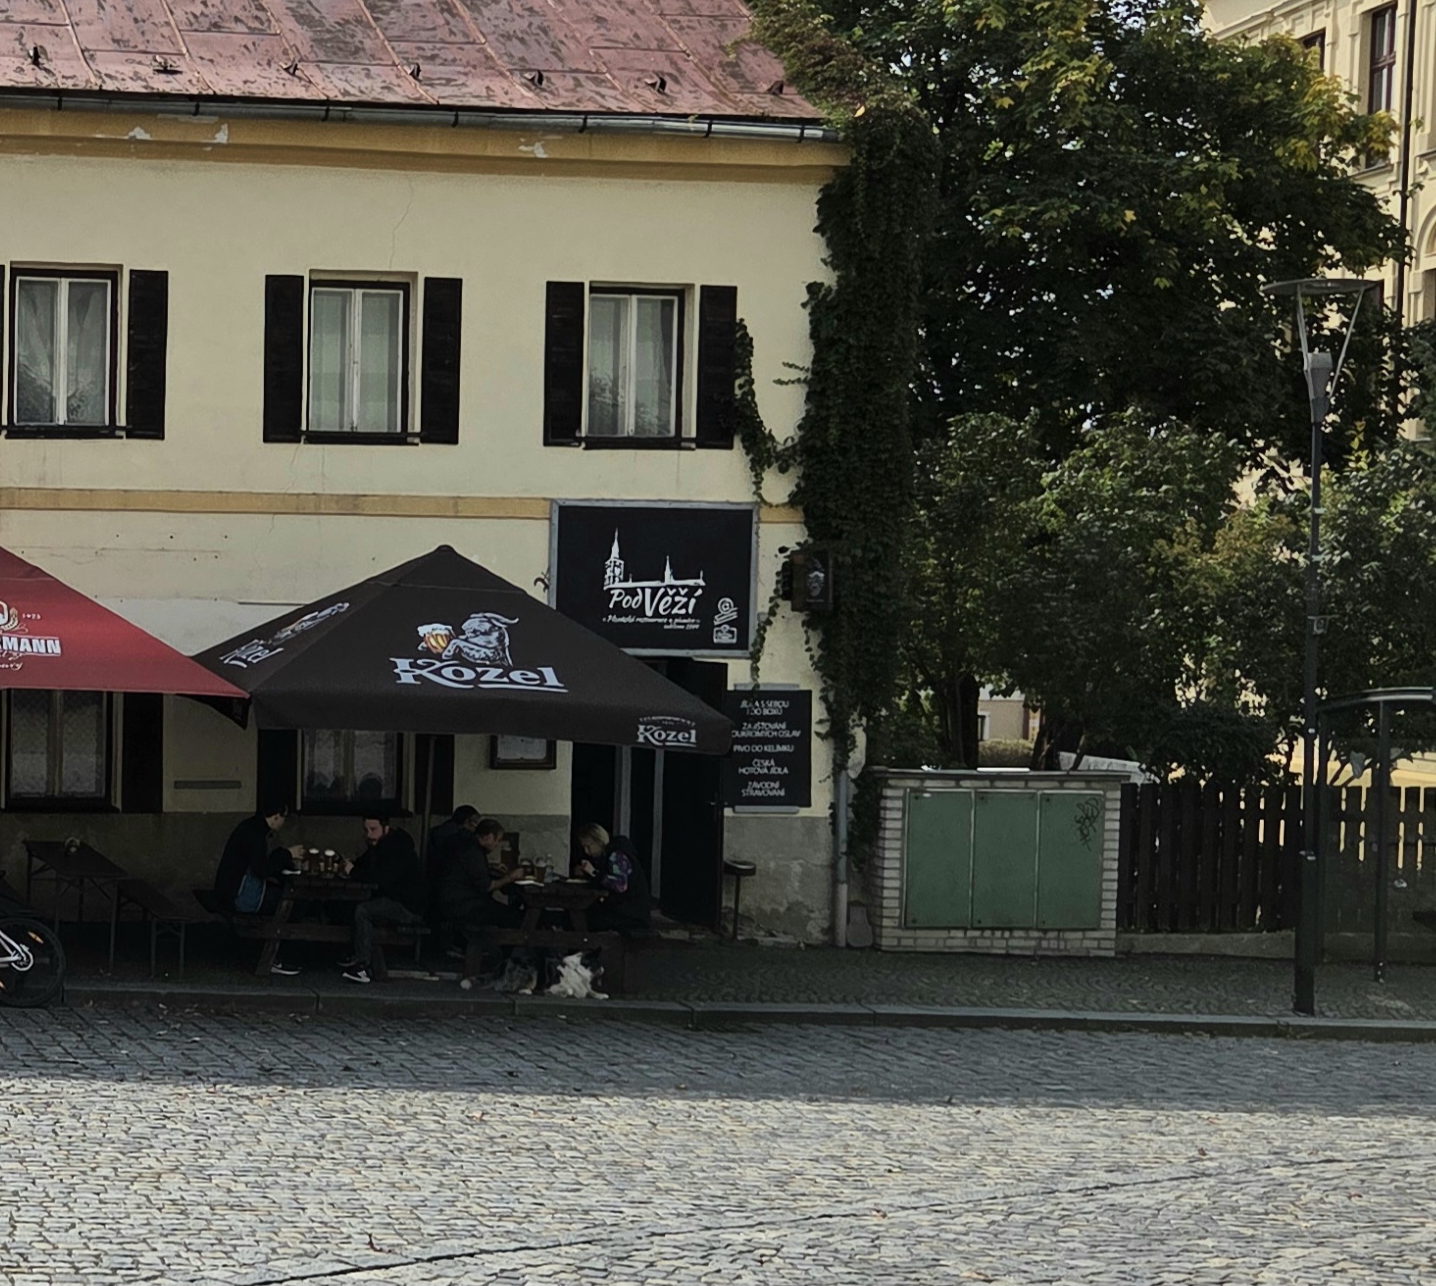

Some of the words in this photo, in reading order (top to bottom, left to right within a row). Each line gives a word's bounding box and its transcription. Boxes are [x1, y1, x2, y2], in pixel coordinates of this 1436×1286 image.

[609, 588, 643, 609] Pod
[645, 587, 703, 617] Věží
[389, 658, 568, 693] Kozel
[637, 724, 697, 747] Kozel
[731, 729, 777, 738] OUKROMÝCH
